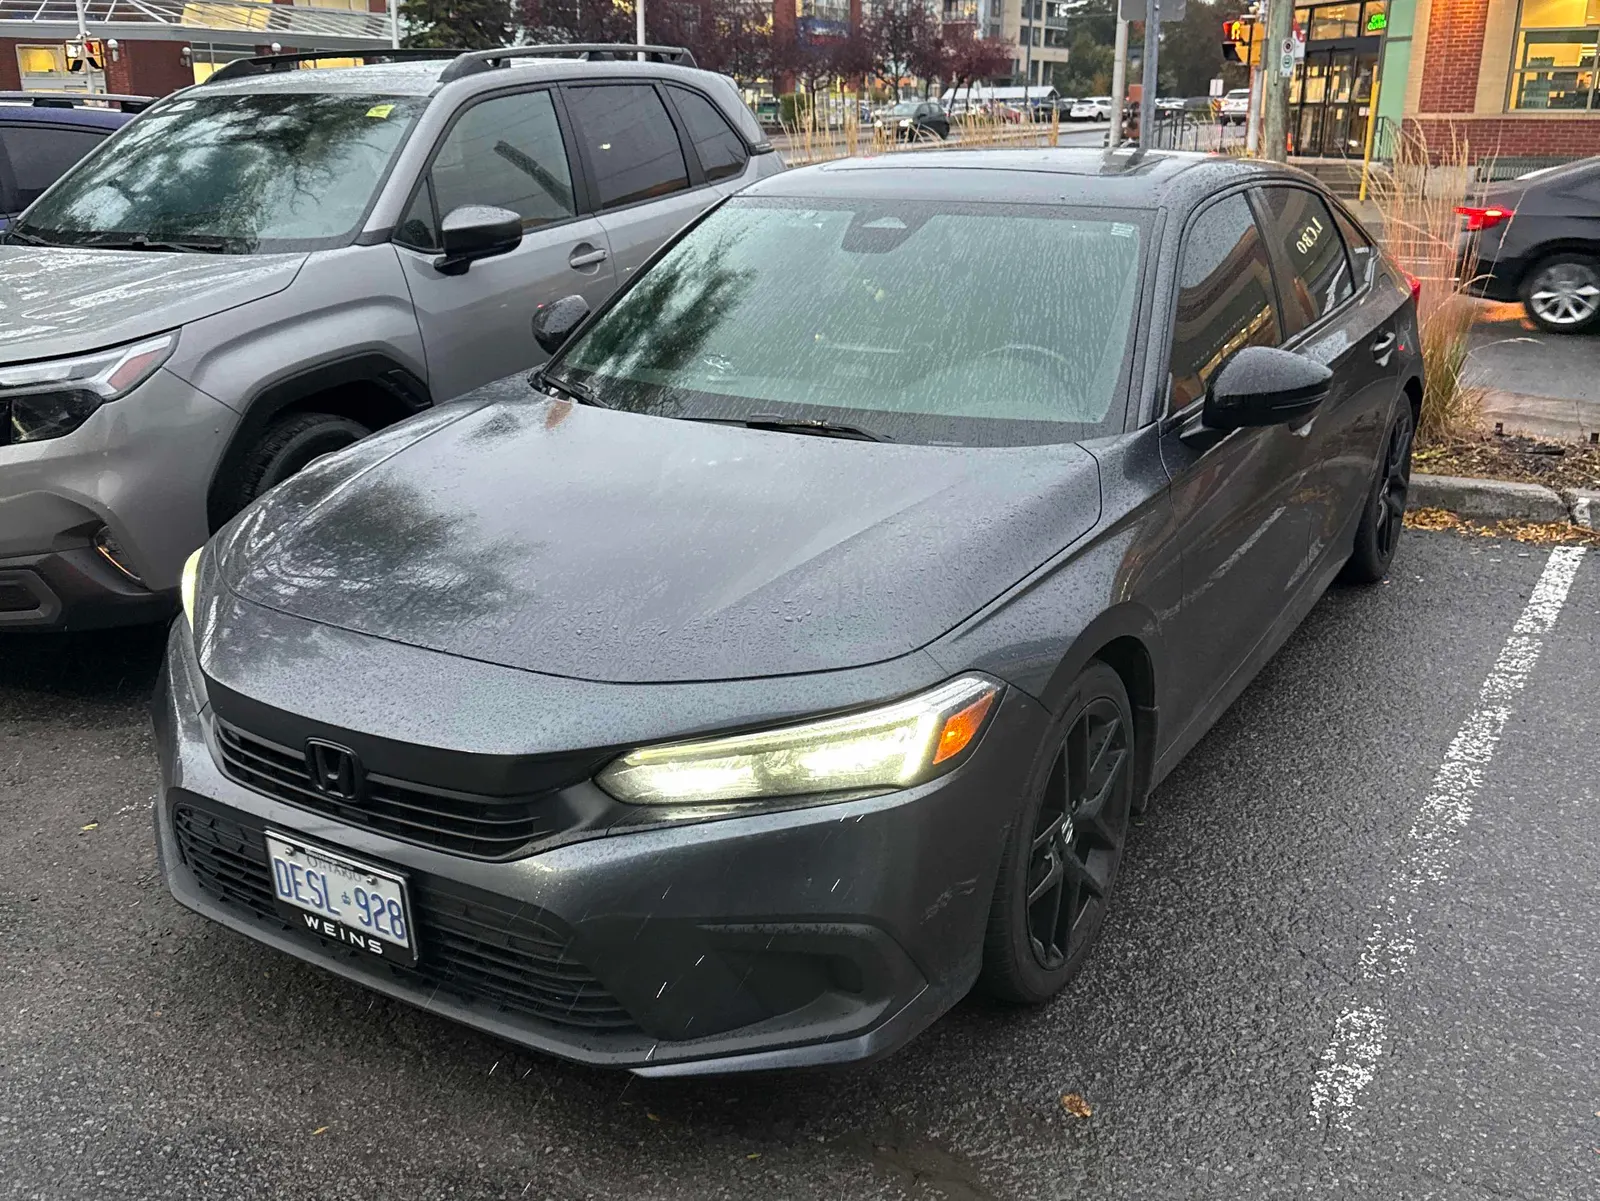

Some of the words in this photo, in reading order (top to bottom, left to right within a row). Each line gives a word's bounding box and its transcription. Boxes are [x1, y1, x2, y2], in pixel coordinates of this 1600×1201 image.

[273, 857, 341, 916] DESL
[354, 887, 405, 940] 928
[303, 913, 383, 955] WEINS
